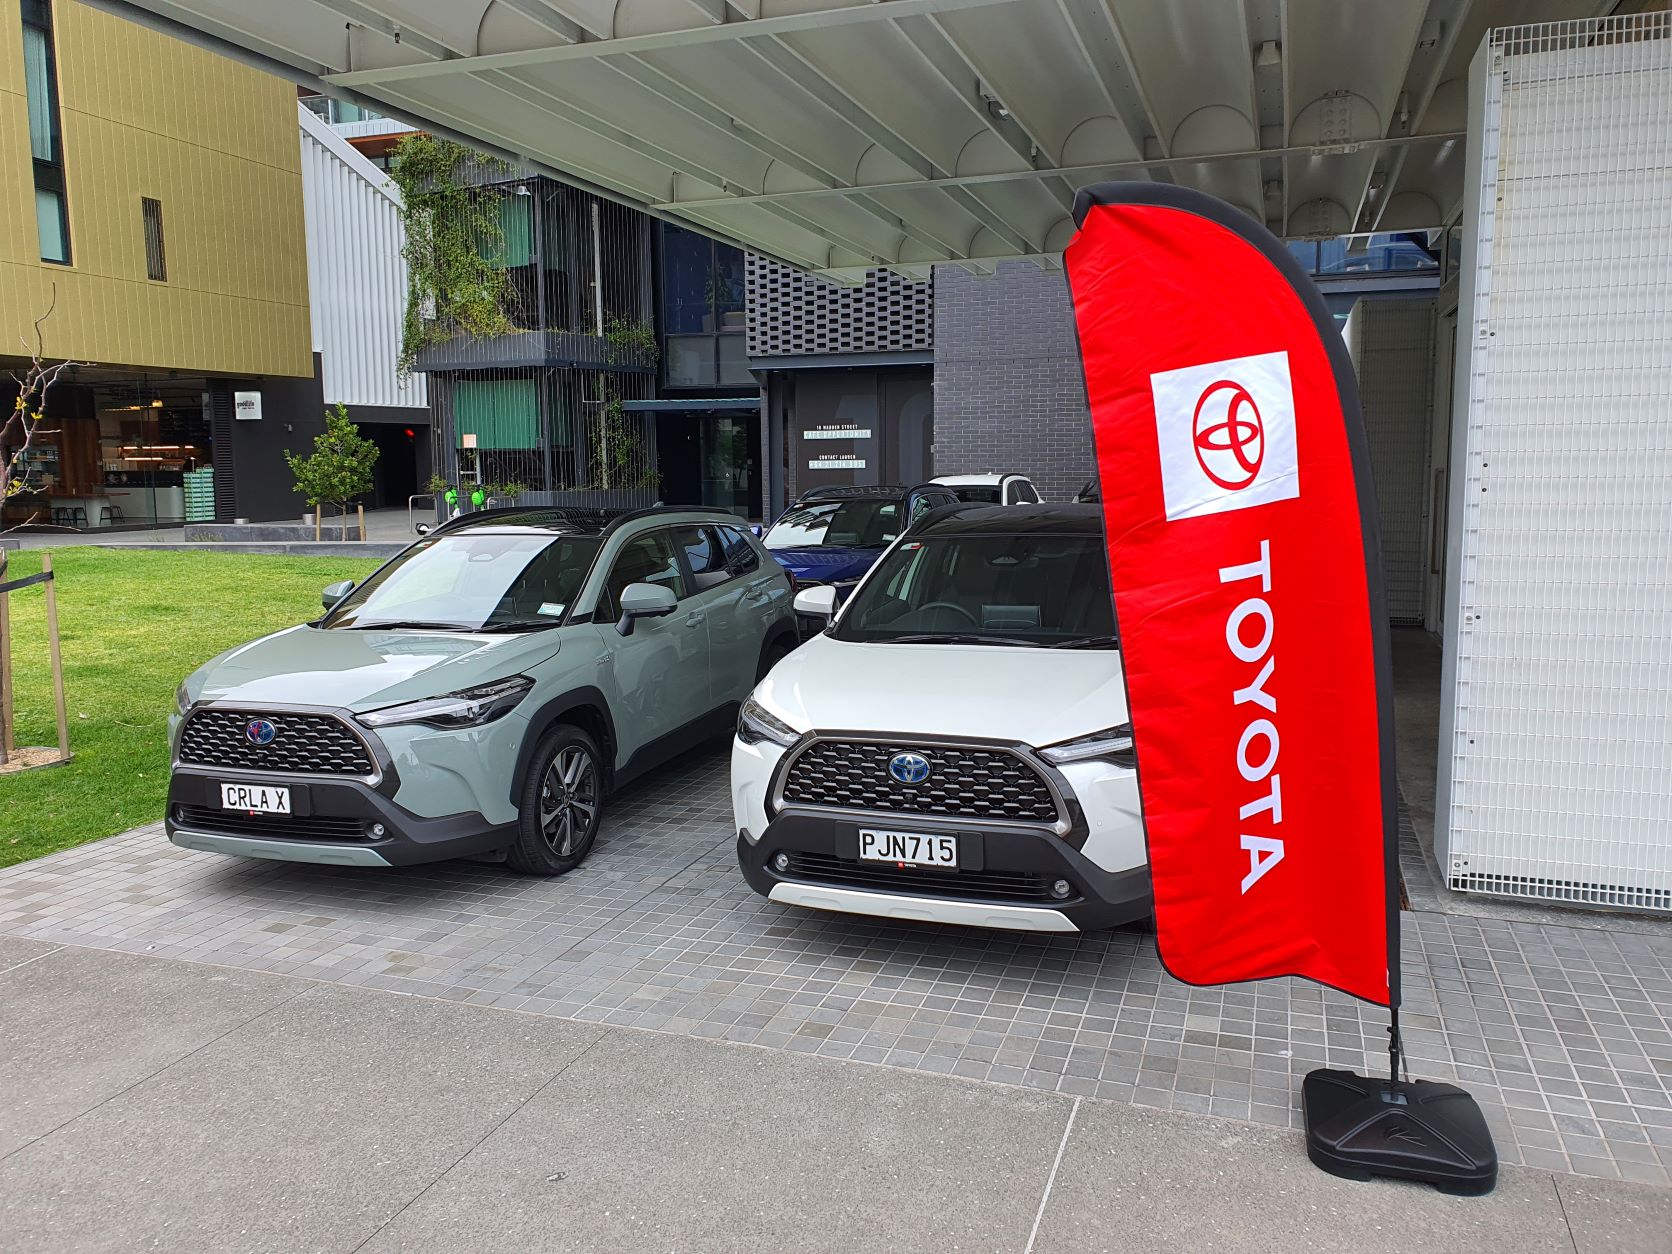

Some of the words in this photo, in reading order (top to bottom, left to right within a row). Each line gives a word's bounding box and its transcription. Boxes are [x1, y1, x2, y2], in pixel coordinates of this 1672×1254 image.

[1218, 539, 1285, 896] TOYOTA
[227, 786, 269, 809] CRLA
[275, 790, 286, 811] X
[861, 832, 954, 863] PJN715
